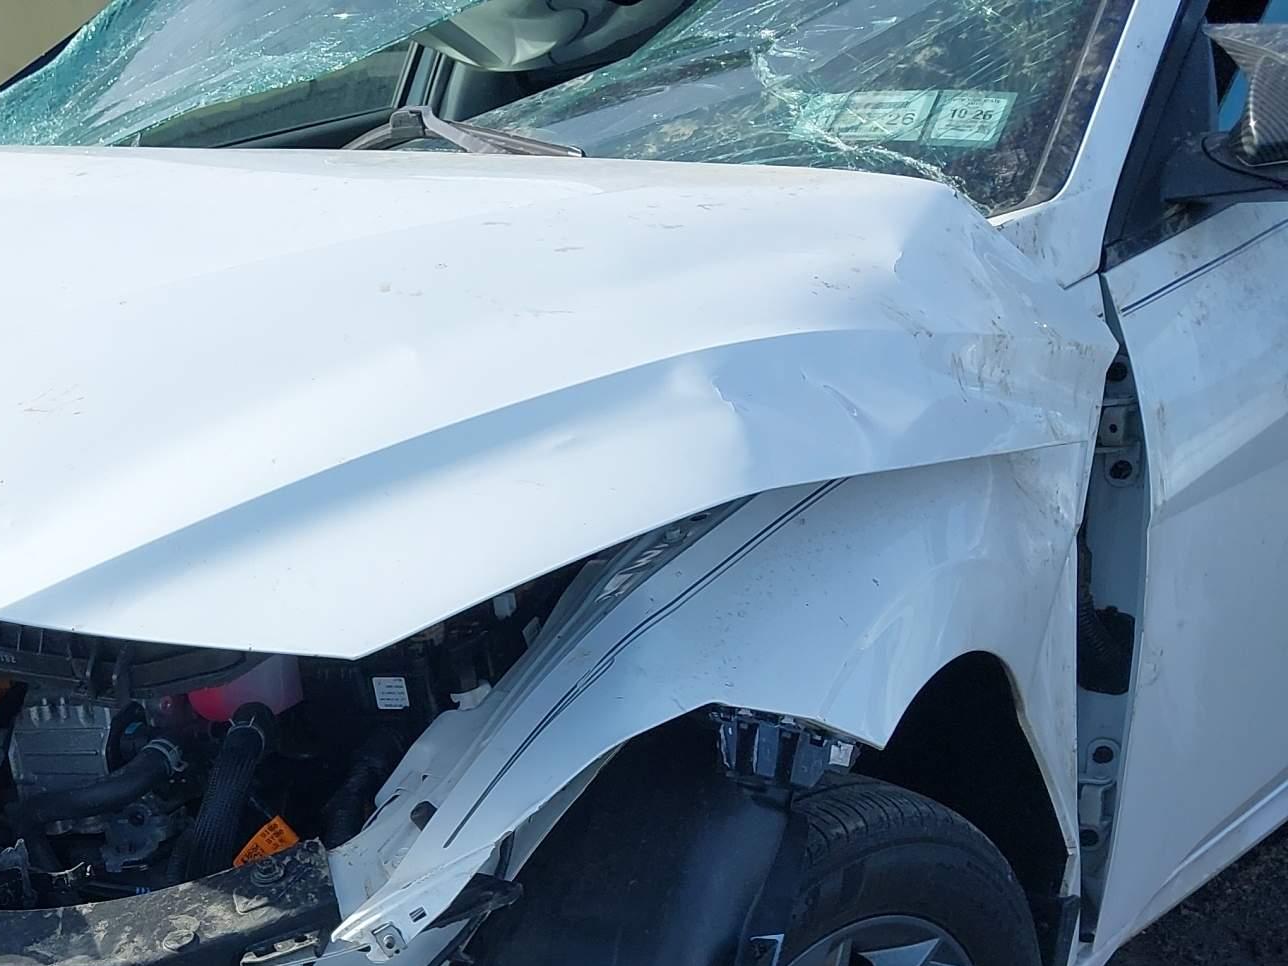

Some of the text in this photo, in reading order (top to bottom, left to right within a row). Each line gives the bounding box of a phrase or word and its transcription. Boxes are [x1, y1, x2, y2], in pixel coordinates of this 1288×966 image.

[884, 111, 916, 126] 26
[950, 107, 994, 121] 10 26
